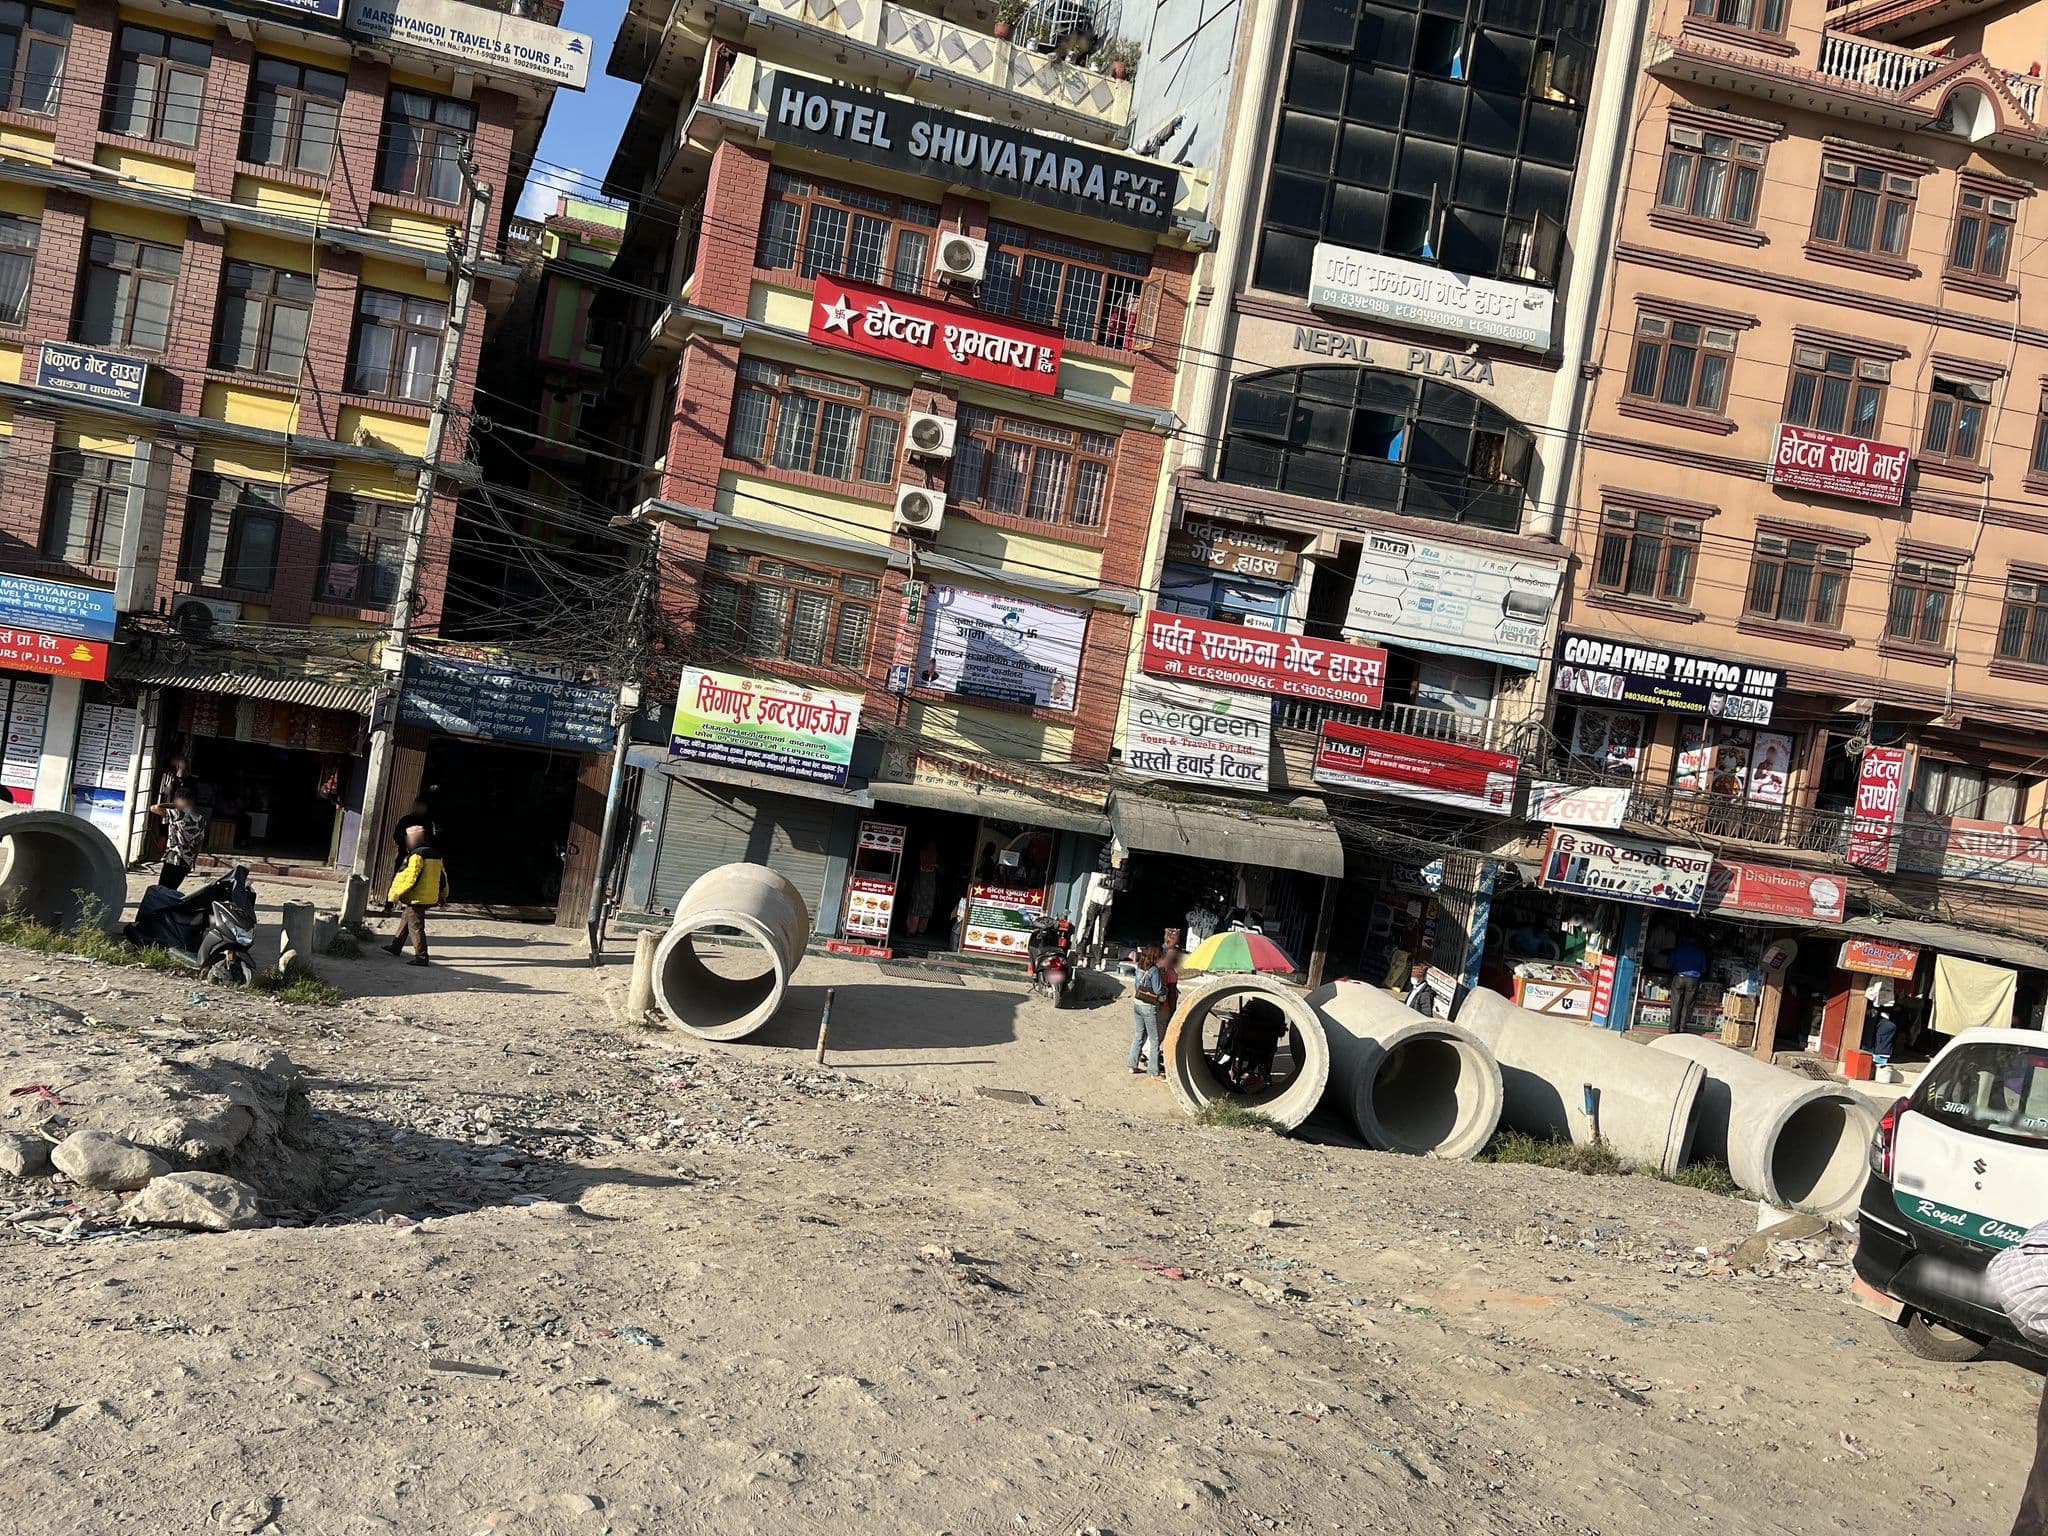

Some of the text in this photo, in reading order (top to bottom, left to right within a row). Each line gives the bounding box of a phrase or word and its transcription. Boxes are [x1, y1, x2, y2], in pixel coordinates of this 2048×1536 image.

[362, 6, 445, 39] MARSHYANGDI
[450, 29, 502, 52] TRAVEL'S
[504, 43, 511, 54] &
[513, 45, 551, 65] TOURS
[554, 57, 563, 69] P.
[390, 26, 405, 38] New
[436, 38, 446, 48] Tel
[778, 87, 1166, 201] HOTEL SHUVATARA PVT.
[1110, 189, 1163, 218] LTD.
[864, 300, 935, 346] होटल
[943, 323, 1037, 369] शुभतारा
[1293, 325, 1496, 387] NEPAL PLAZA
[84, 354, 109, 376] गेष्ट
[109, 361, 142, 383] हाउस
[1778, 429, 1828, 470] होटल
[1829, 442, 1872, 477] साथी
[1872, 450, 1906, 485] भाई
[1187, 519, 1227, 544] पर्वत
[1374, 539, 1409, 556] IME
[1237, 553, 1281, 576] हाउस
[0, 579, 90, 602] MARSHYANGDI
[1513, 574, 1551, 589] MoneyGram
[23, 592, 31, 600] &
[33, 593, 66, 606] TOURS
[83, 603, 104, 613] LTD.
[1354, 605, 1393, 620] Money Transfer
[956, 625, 986, 641] आमा
[1254, 619, 1272, 628] THAI
[16, 633, 35, 647] प्रा.
[38, 633, 60, 651] लि.
[1501, 629, 1541, 647] remit
[21, 651, 41, 664] (P.)
[43, 654, 66, 666] LTD.
[1152, 619, 1195, 655] पर्वत
[1199, 630, 1280, 669] सम्झना
[1283, 638, 1325, 677] गेष्ट
[1327, 653, 1382, 687] हाउस
[1164, 659, 1184, 674] मो.
[1564, 636, 1671, 680] GODFATHER
[1673, 656, 1741, 692] TATTOO
[1742, 668, 1778, 698] INN
[1653, 686, 1682, 699] Contact:
[695, 673, 852, 737] सिंगापुर इन्टरप्राइजेज
[1139, 705, 1260, 739] evergreen
[1140, 731, 1168, 744] Tours
[1169, 736, 1177, 744] &
[1330, 742, 1363, 757] IME
[1130, 747, 1265, 782] सस्तो हवाई टिकट
[1862, 754, 1903, 780] होटल
[1859, 782, 1898, 813] साथी
[1557, 832, 1578, 852] डि
[1580, 839, 1617, 865] आर
[1745, 868, 1807, 889] DishHome
[1916, 1200, 1968, 1227] Royal
